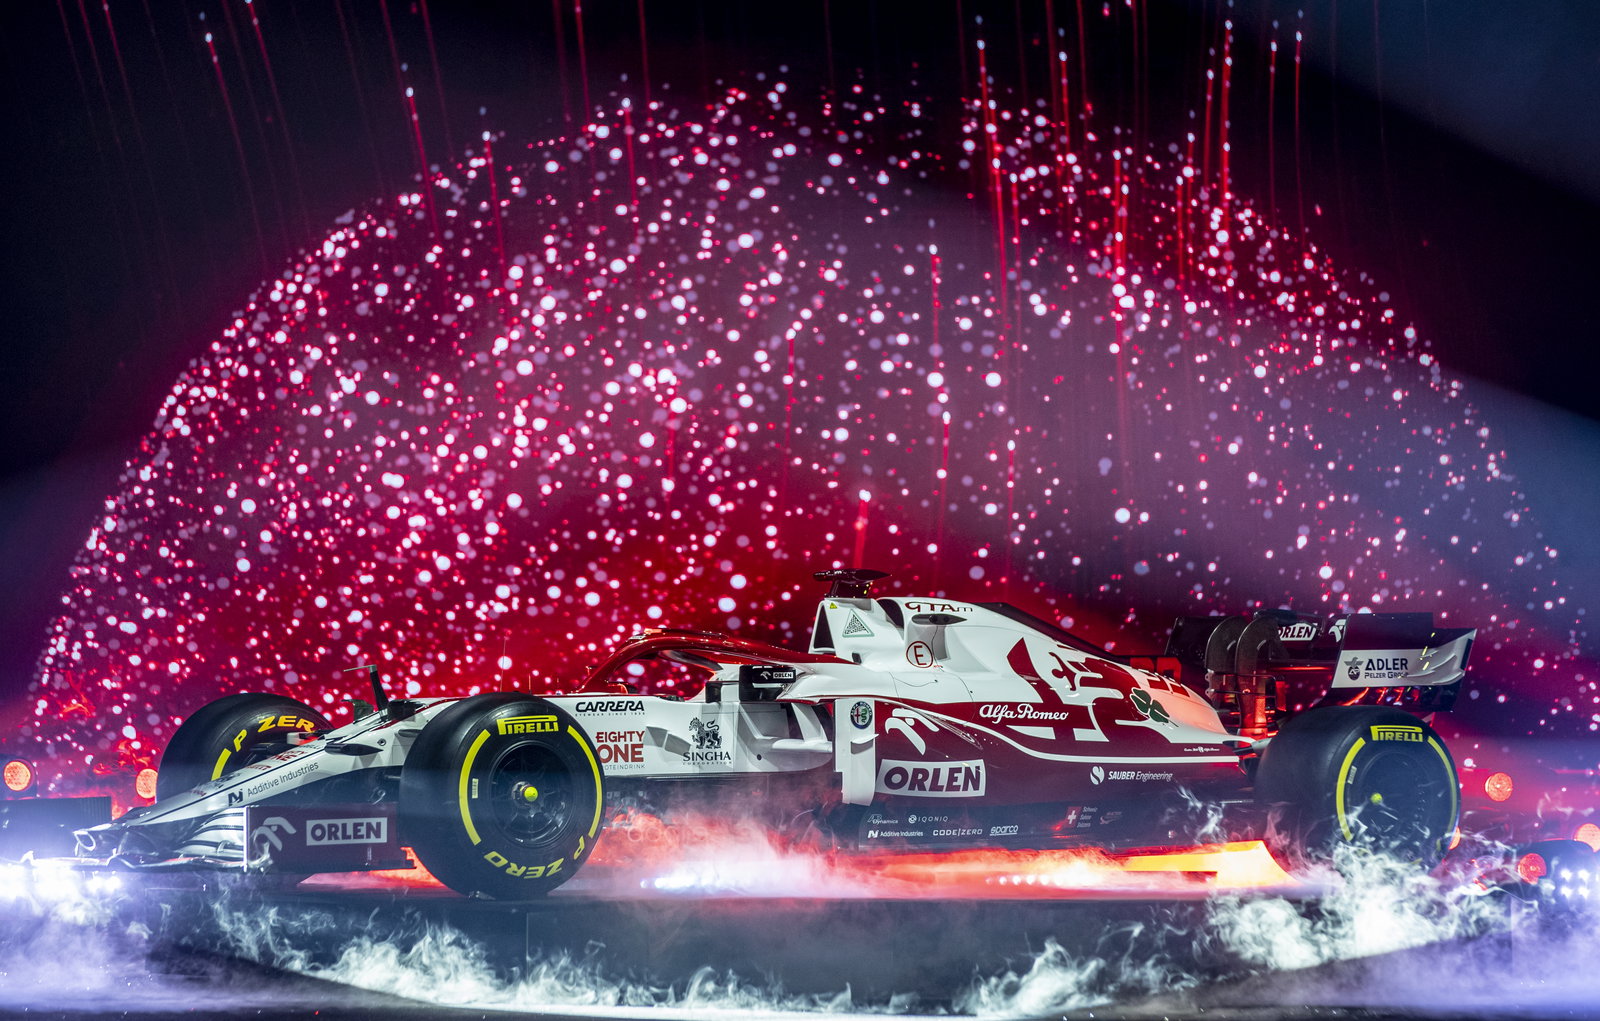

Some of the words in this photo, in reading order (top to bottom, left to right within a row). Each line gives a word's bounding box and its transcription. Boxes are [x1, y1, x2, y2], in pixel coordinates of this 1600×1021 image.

[913, 645, 927, 666] E
[1364, 658, 1409, 671] ADLER
[575, 700, 645, 713] CARRERA
[979, 704, 1018, 724] Alfa
[1017, 702, 1069, 721] Romeo
[232, 729, 248, 752] P
[257, 715, 317, 733] ZER
[497, 714, 560, 736] PIRELLI
[1370, 725, 1424, 743] PIRELLI
[595, 731, 645, 743] EIGHTY
[597, 743, 645, 764] ONE
[682, 751, 732, 762] SINGHA
[604, 763, 646, 771] OTEINDRINK
[1107, 771, 1136, 780] SAUBER
[1135, 771, 1174, 783] Engineering
[247, 777, 280, 798] Additive
[280, 762, 320, 784] Industries
[883, 765, 981, 793] ORLEN
[917, 815, 949, 824] IQONIQ
[310, 821, 382, 842] ORLEN
[990, 824, 1019, 837] sparco
[573, 835, 585, 860] P
[483, 850, 565, 880] ZERO
